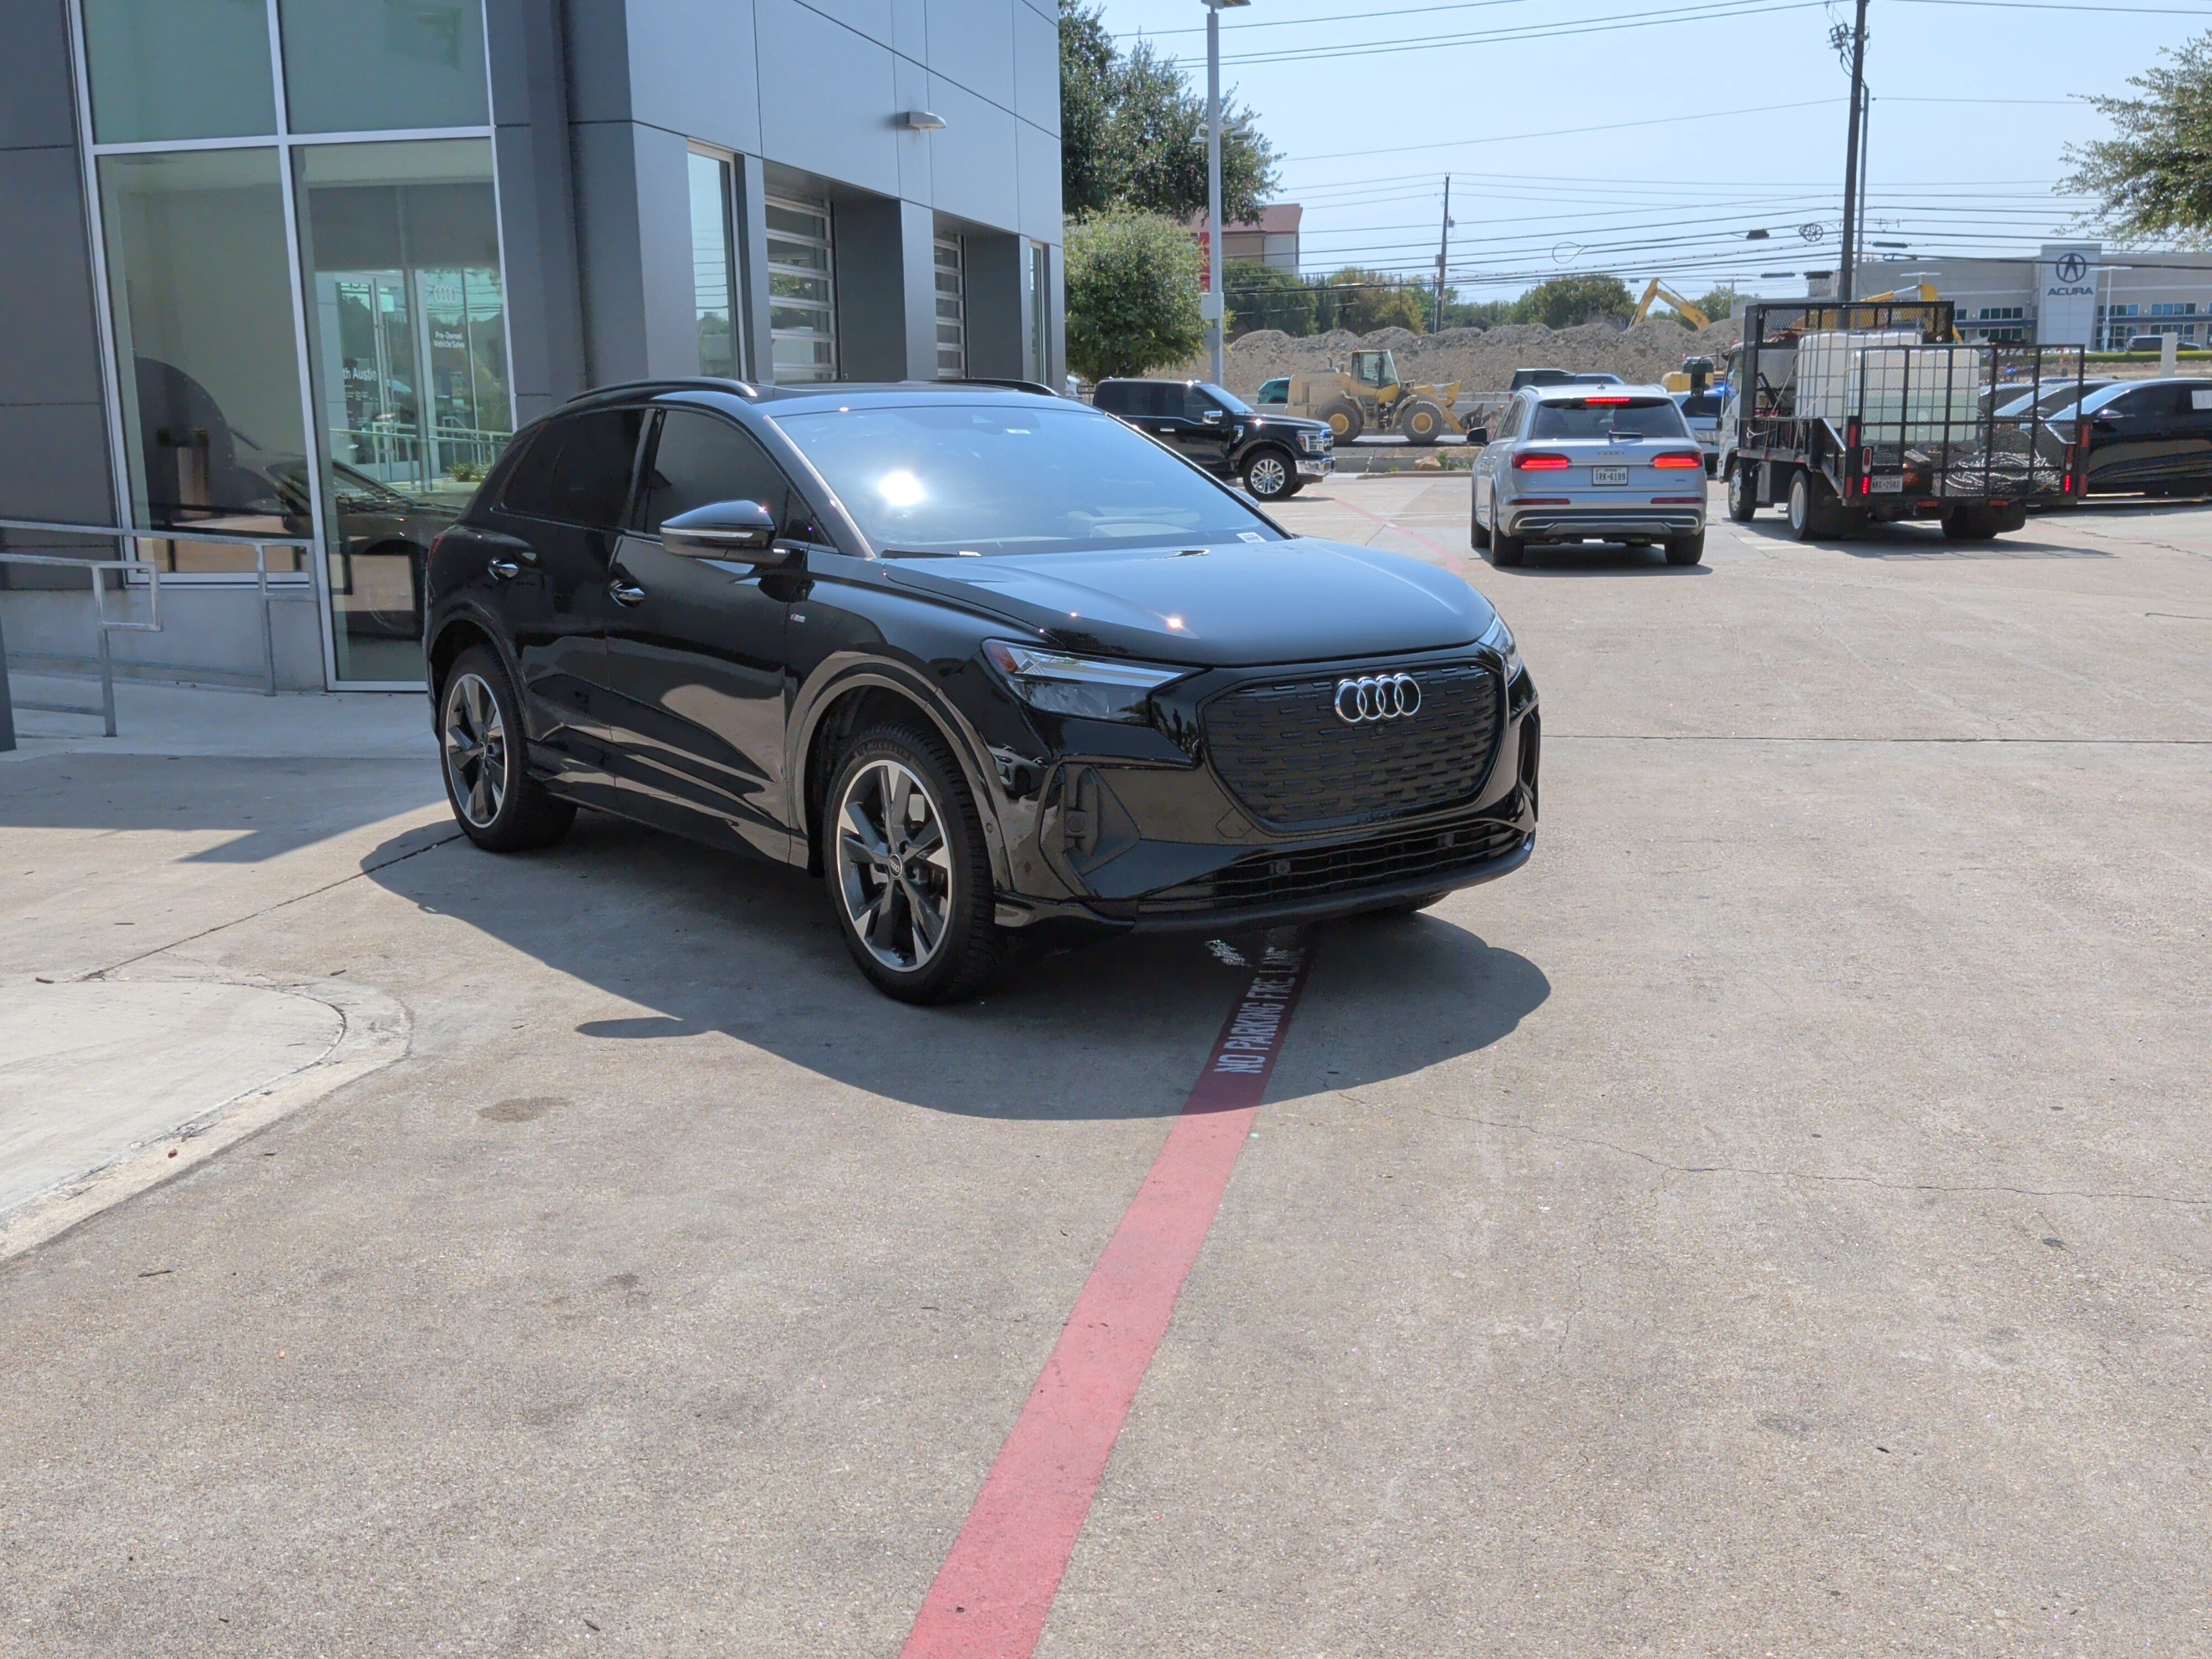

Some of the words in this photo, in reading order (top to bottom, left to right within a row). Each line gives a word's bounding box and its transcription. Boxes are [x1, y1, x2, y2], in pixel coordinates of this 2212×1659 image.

[2047, 286, 2094, 296] ACURA
[353, 367, 377, 381] Austin
[1245, 977, 1297, 999] FIRE
[1223, 1002, 1286, 1051] PARKING
[1213, 1053, 1265, 1074] NO
